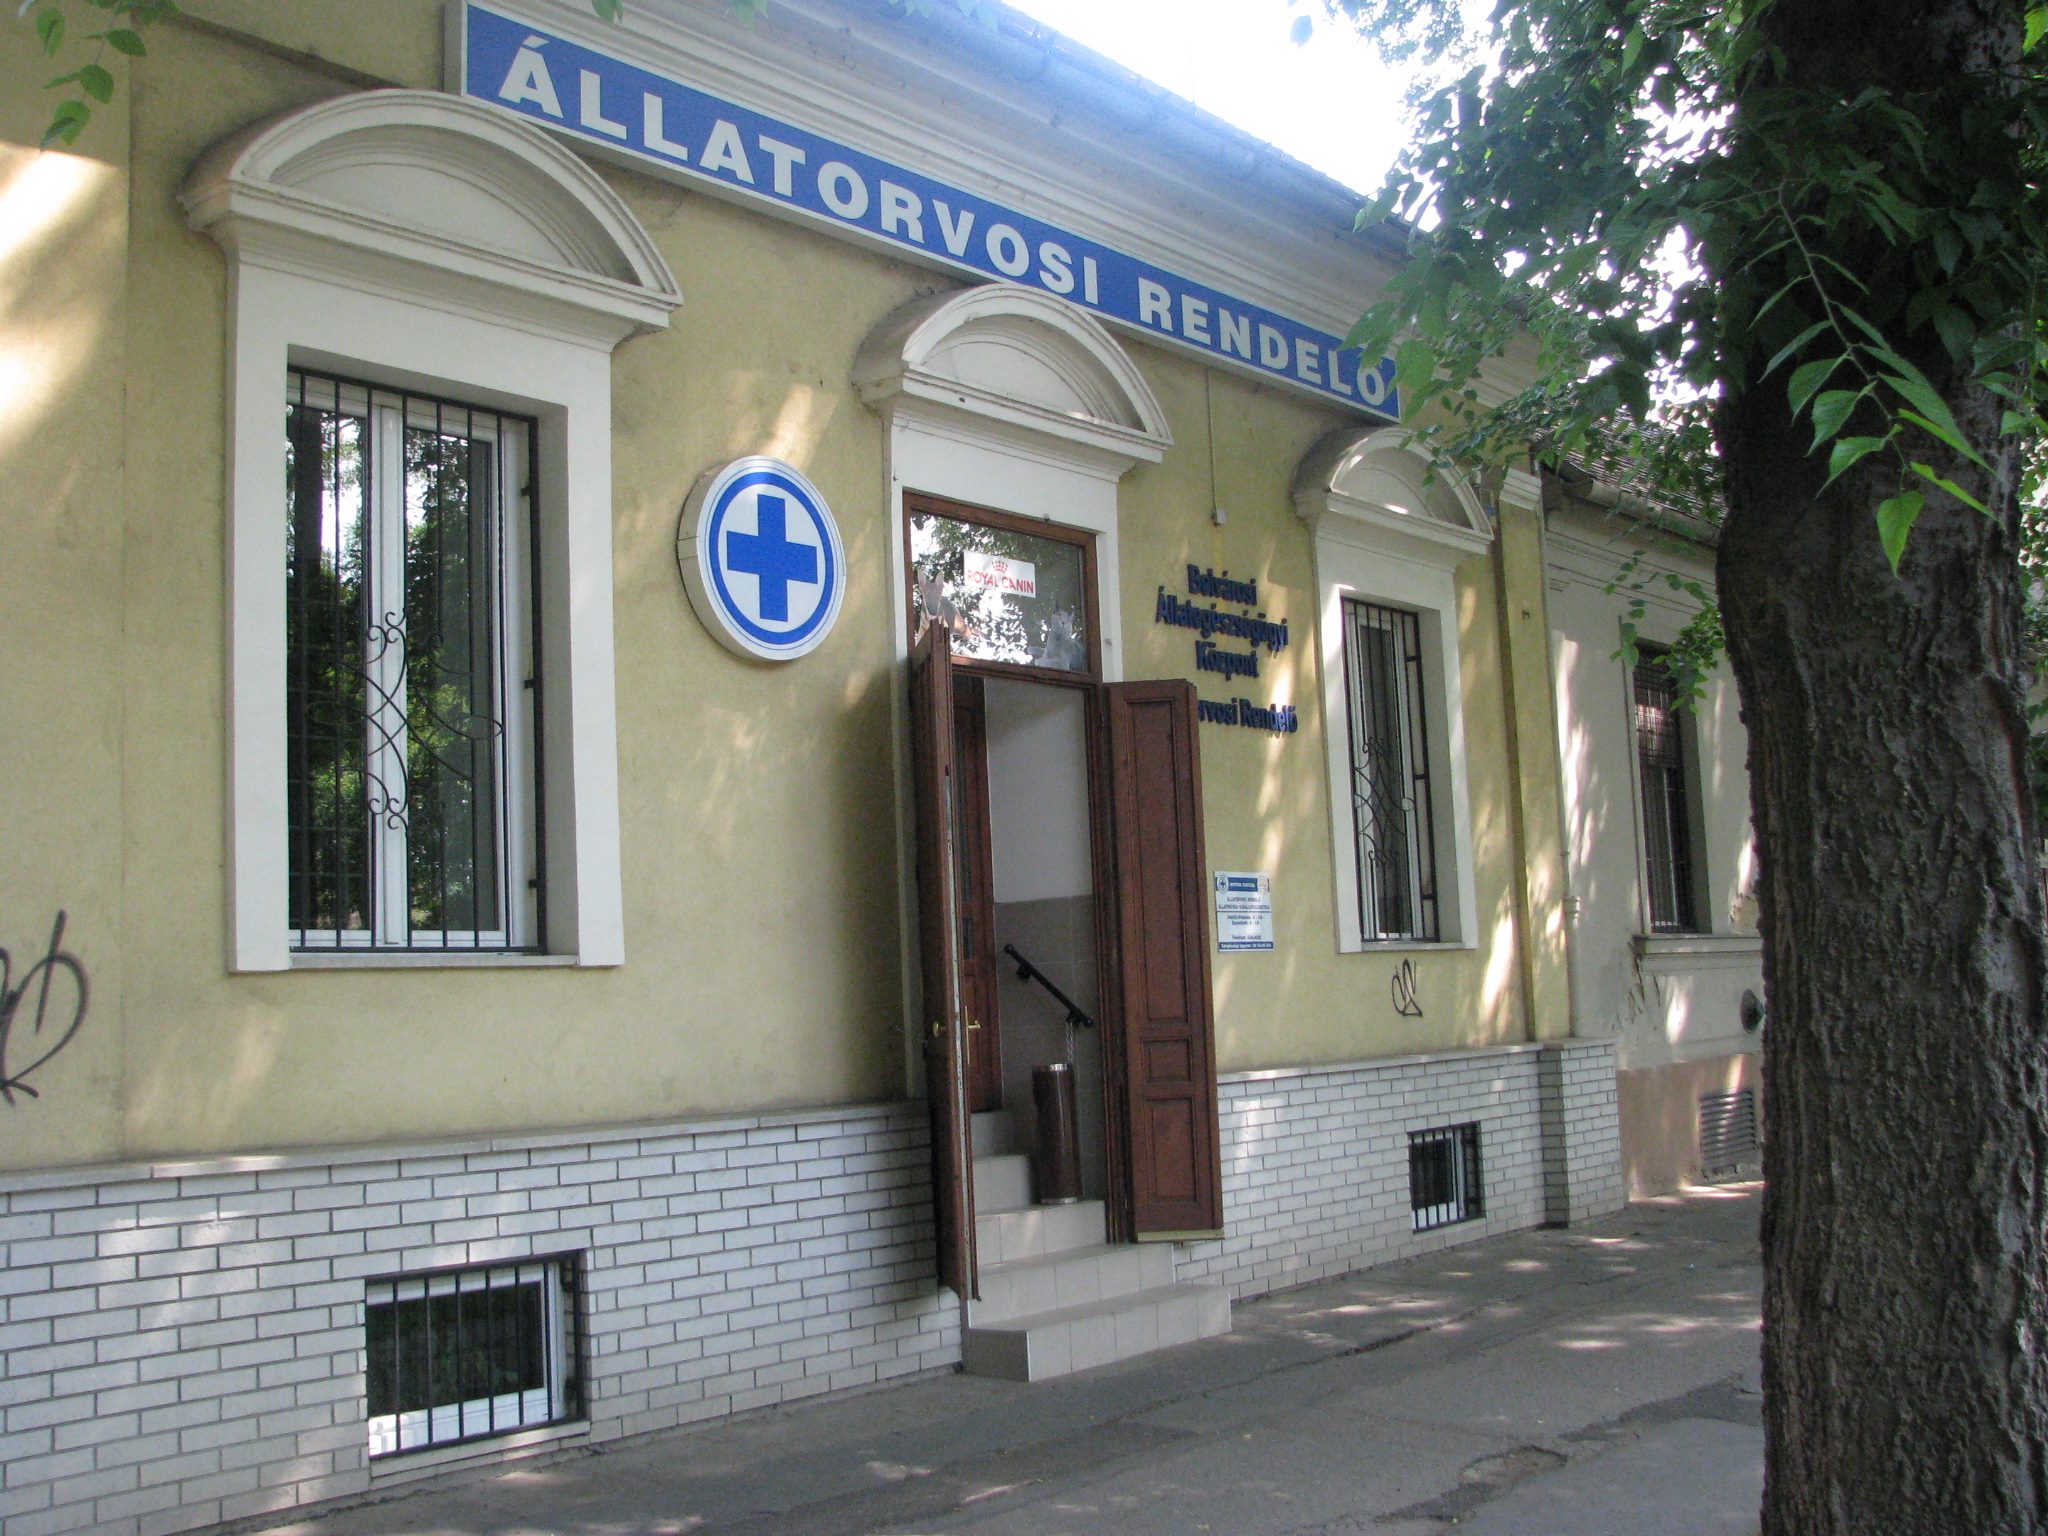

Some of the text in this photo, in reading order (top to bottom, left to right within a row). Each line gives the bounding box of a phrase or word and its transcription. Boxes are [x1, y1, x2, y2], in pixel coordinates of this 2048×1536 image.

[498, 36, 1099, 304] ÁLLATORVOSI
[967, 569, 1034, 595] ROYAL CANIN
[1199, 698, 1238, 725] rvosi
